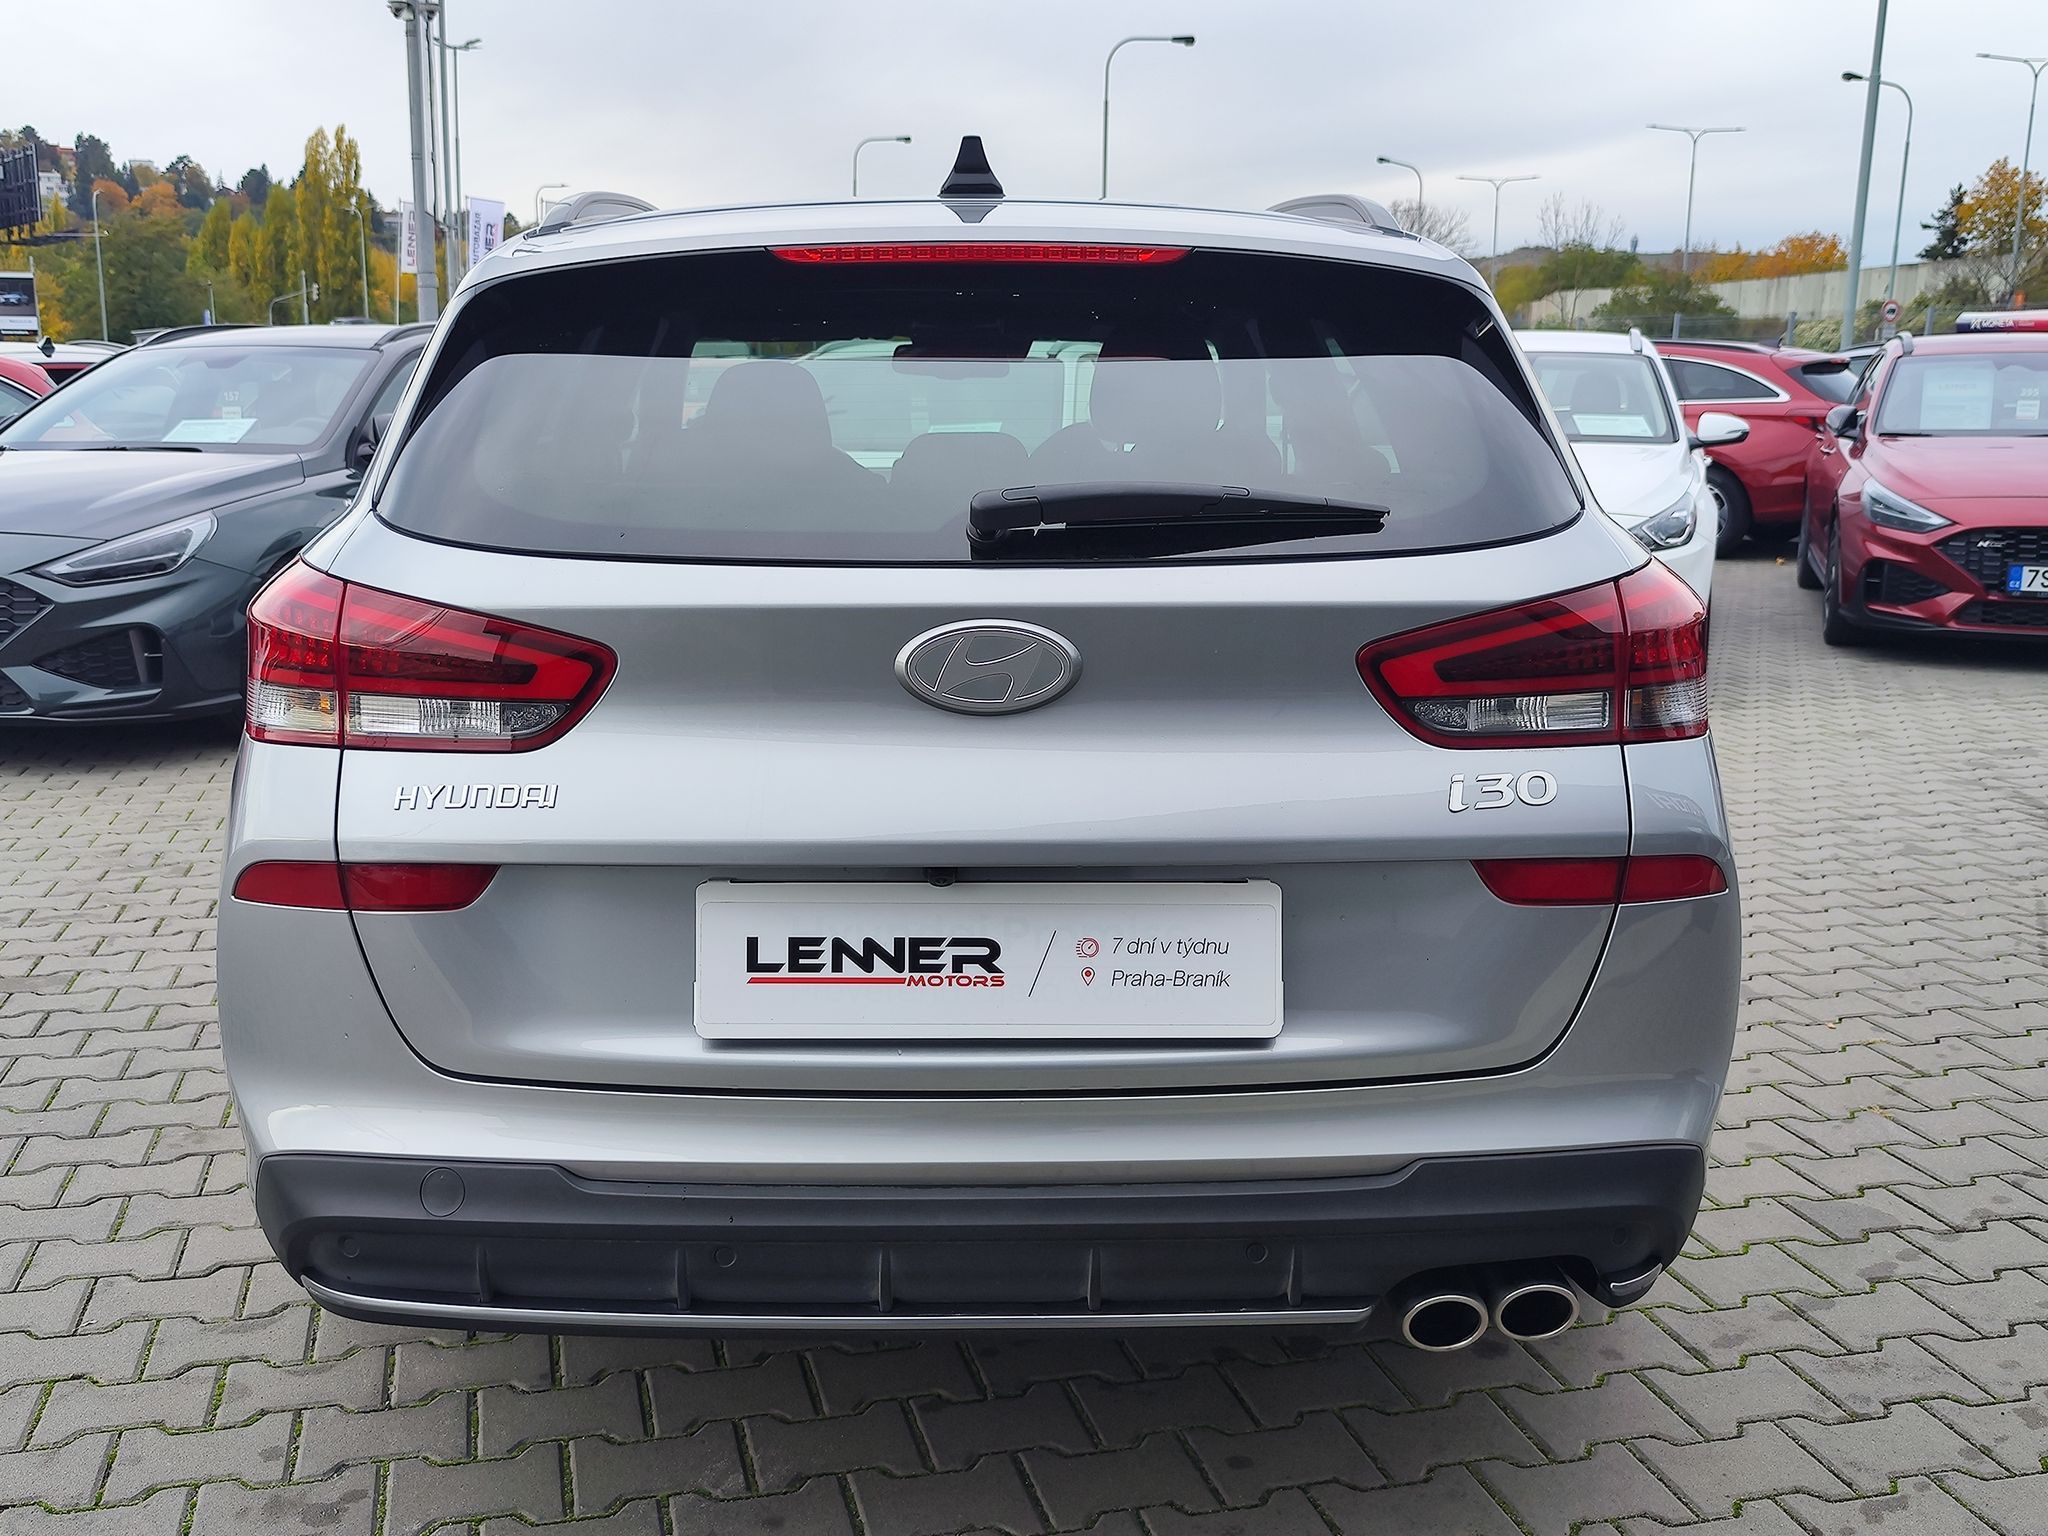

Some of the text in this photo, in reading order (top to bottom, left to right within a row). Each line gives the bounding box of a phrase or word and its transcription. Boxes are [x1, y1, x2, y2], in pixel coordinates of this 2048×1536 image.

[393, 783, 558, 810] HYUNDAI
[1448, 769, 1558, 813] i30
[746, 936, 1005, 973] LENNER
[1112, 936, 1230, 959] 7 dní v týdnu
[905, 975, 1005, 987] MOTORS
[1111, 969, 1231, 987] Praha-Braník
